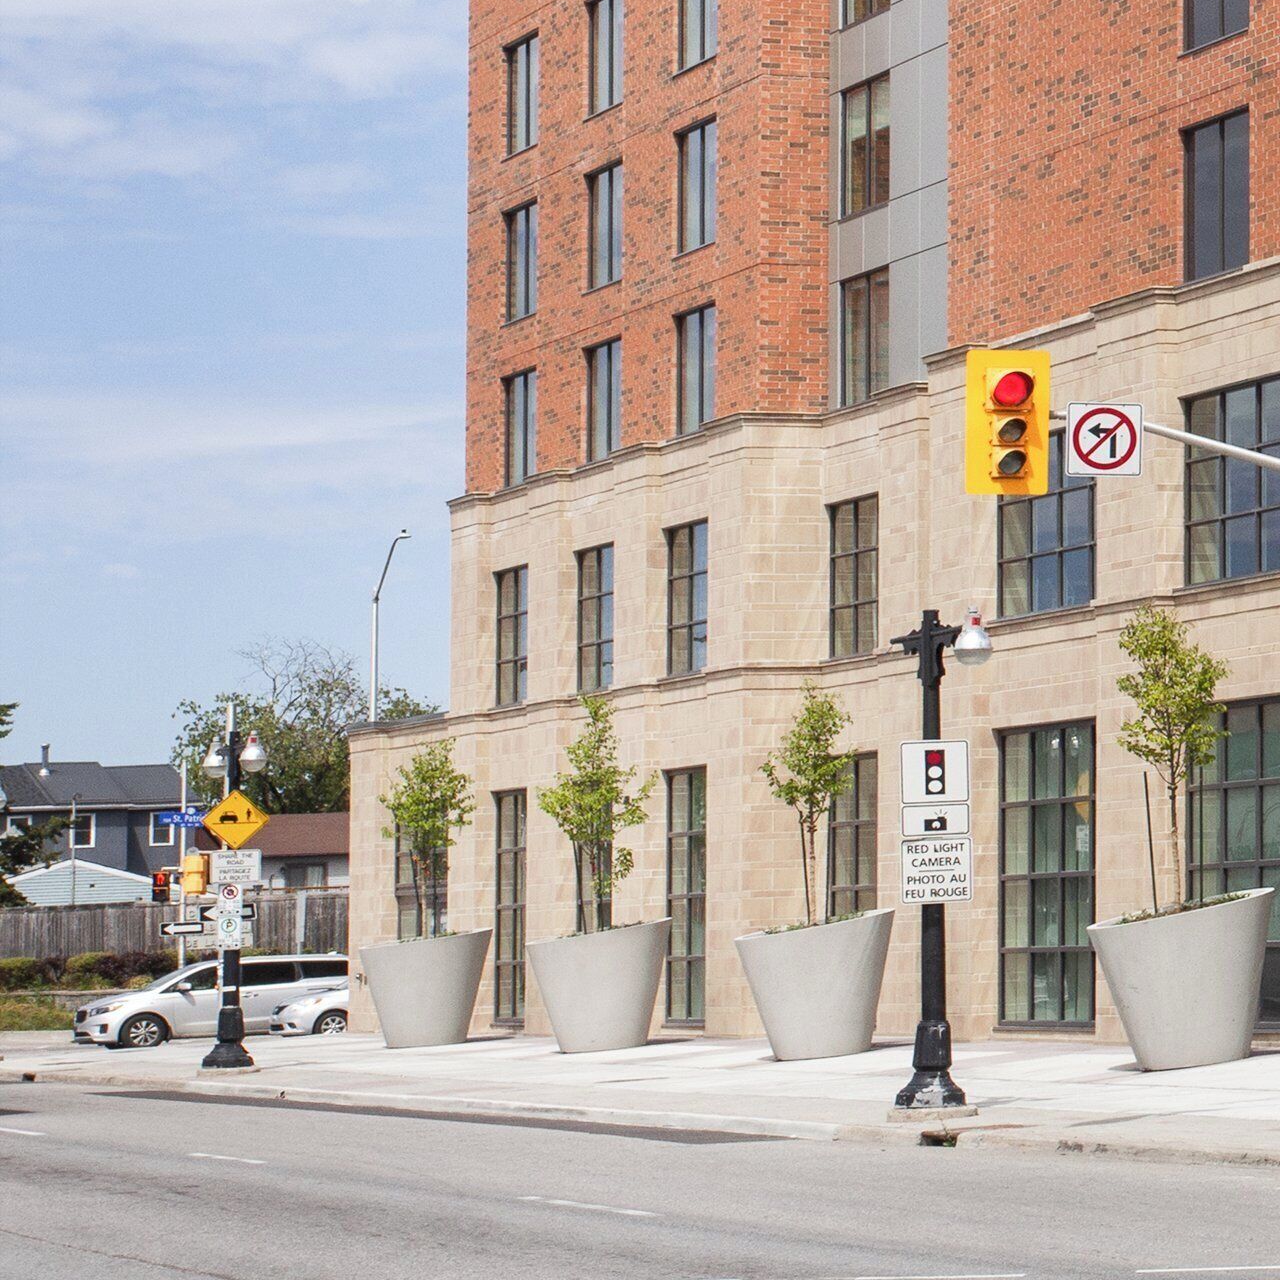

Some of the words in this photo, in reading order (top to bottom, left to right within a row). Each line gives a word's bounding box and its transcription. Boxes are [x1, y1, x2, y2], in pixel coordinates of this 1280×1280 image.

[907, 844, 928, 854] RED
[933, 842, 965, 853] LIGHT
[911, 856, 961, 867] CAMERA
[907, 874, 945, 885] PHOTO
[950, 873, 967, 883] AU
[905, 889, 925, 899] FEU
[930, 886, 968, 897] ROUGE
